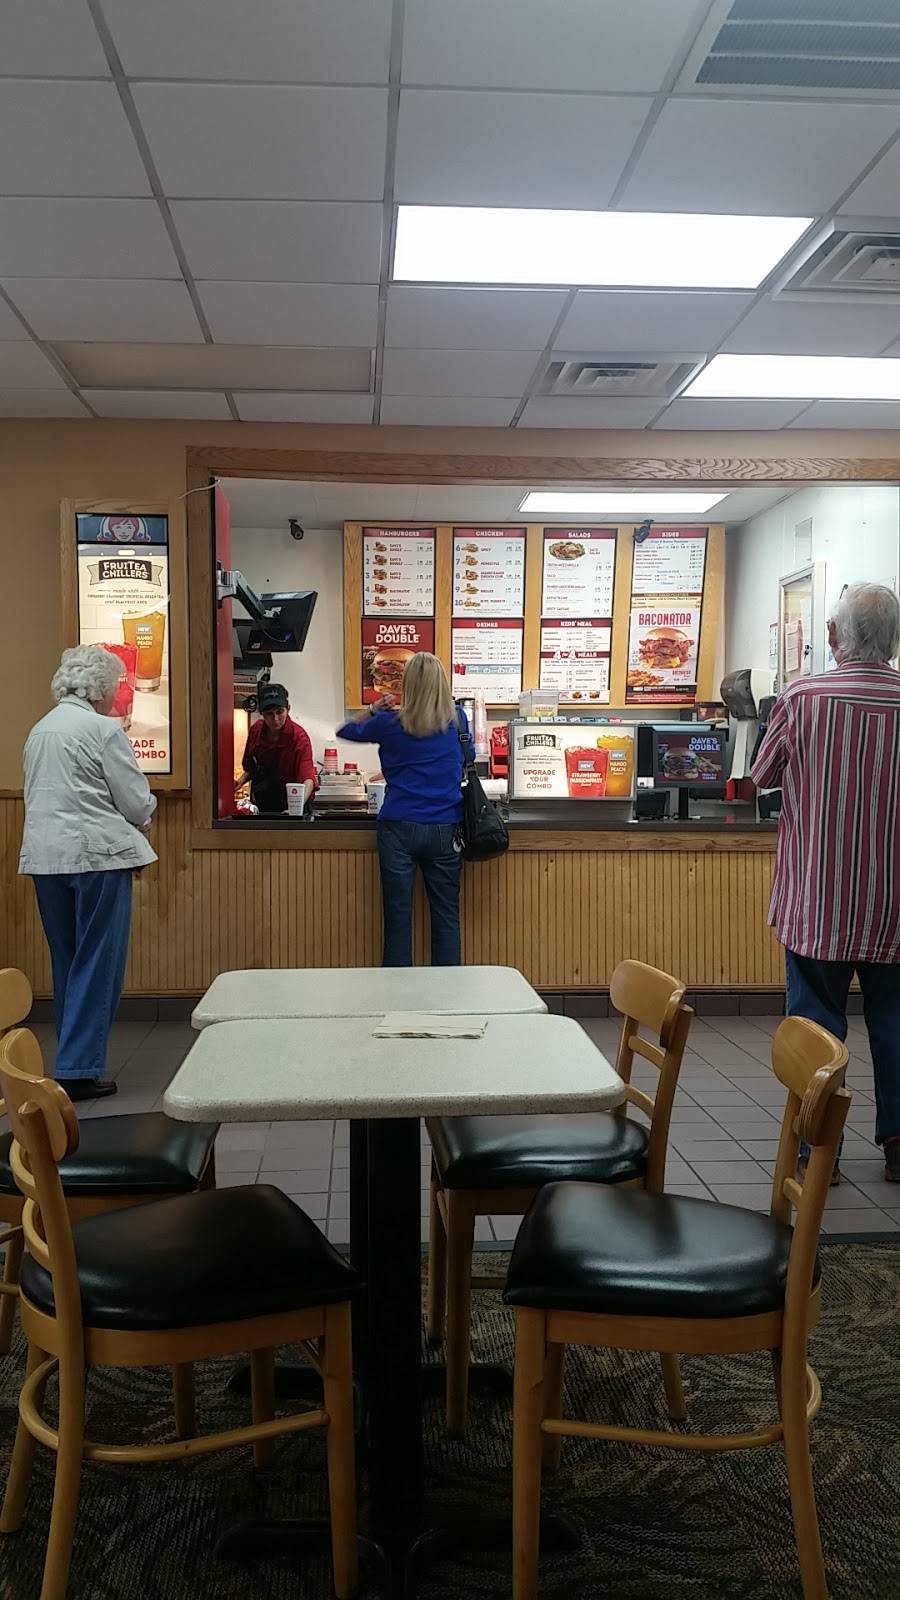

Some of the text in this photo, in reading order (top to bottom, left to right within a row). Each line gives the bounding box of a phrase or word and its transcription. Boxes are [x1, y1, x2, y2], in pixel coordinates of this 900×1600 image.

[103, 561, 147, 572] FRUITEA
[102, 570, 149, 580] CHILLERS
[454, 599, 464, 607] 10
[638, 613, 692, 626] BACONATOR
[379, 624, 417, 634] DAVE'S
[375, 634, 421, 644] DOUBLE
[553, 649, 562, 660] 4
[568, 649, 577, 660] 4
[690, 737, 718, 745] DAVE'S
